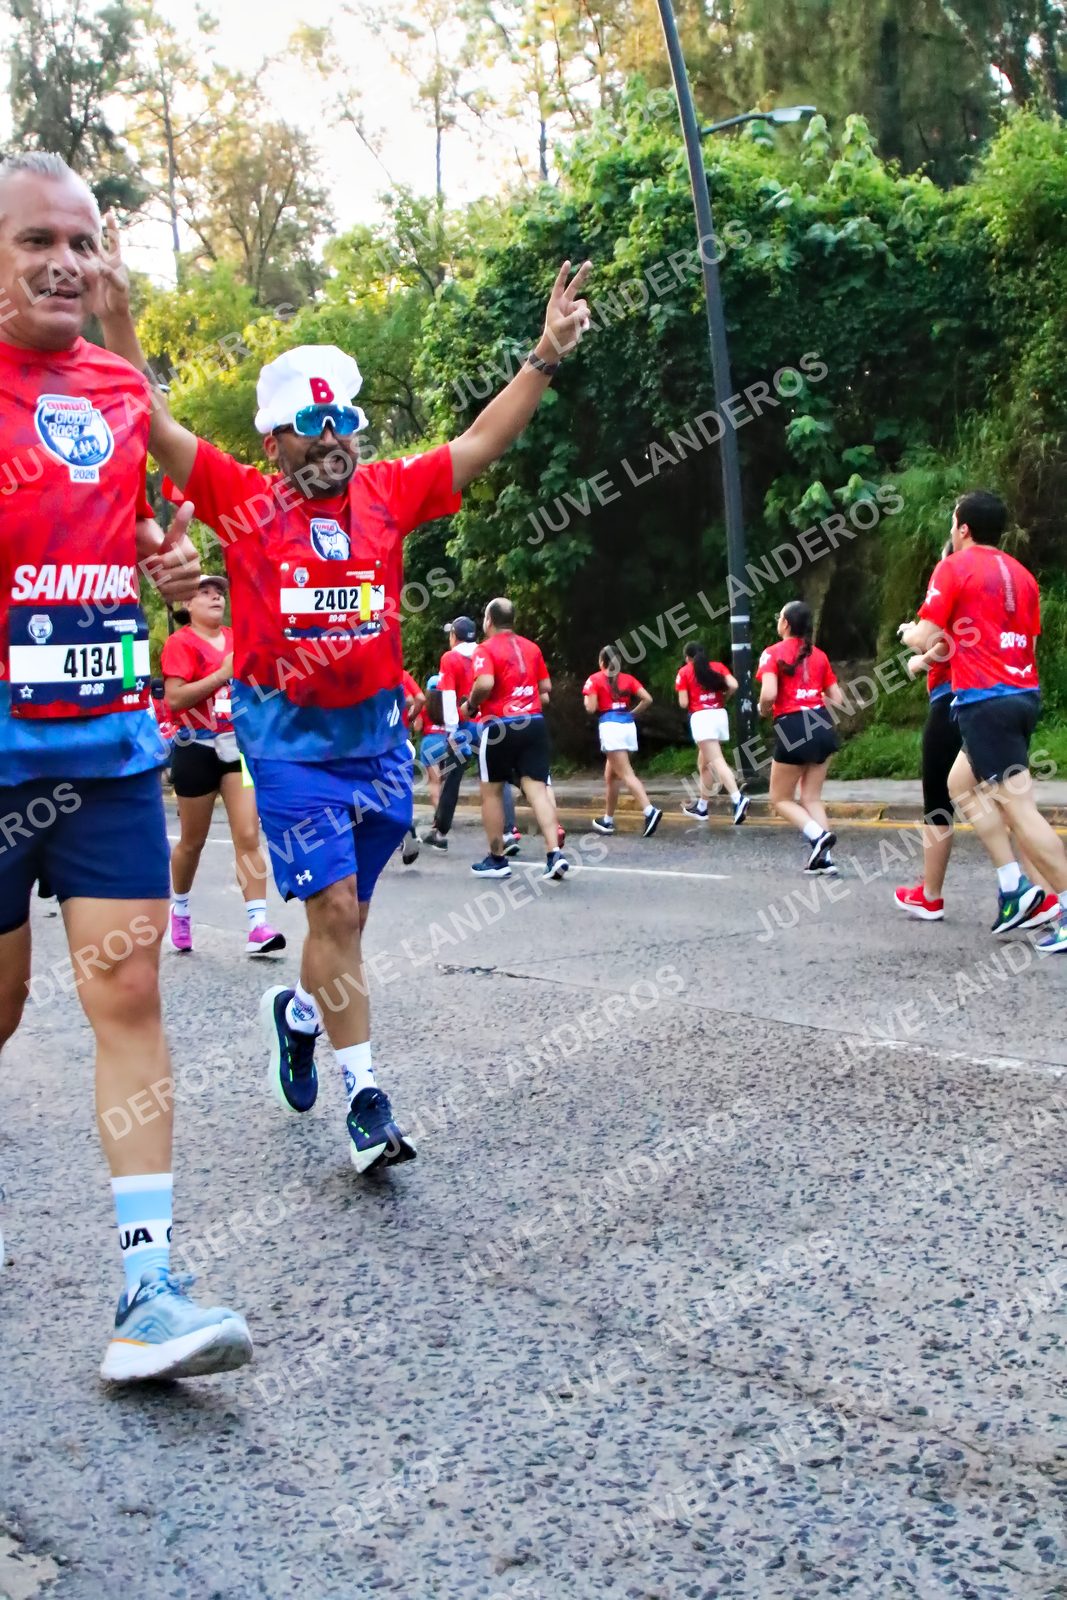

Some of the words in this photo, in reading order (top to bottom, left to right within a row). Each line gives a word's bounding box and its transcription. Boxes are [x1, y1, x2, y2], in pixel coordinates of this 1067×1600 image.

[309, 377, 335, 404] B
[48, 422, 81, 438] Race
[73, 468, 97, 480] 2026
[314, 588, 359, 611] 2402
[63, 645, 118, 679] 4134
[122, 693, 141, 705] 10K
[119, 1227, 154, 1250] UA
